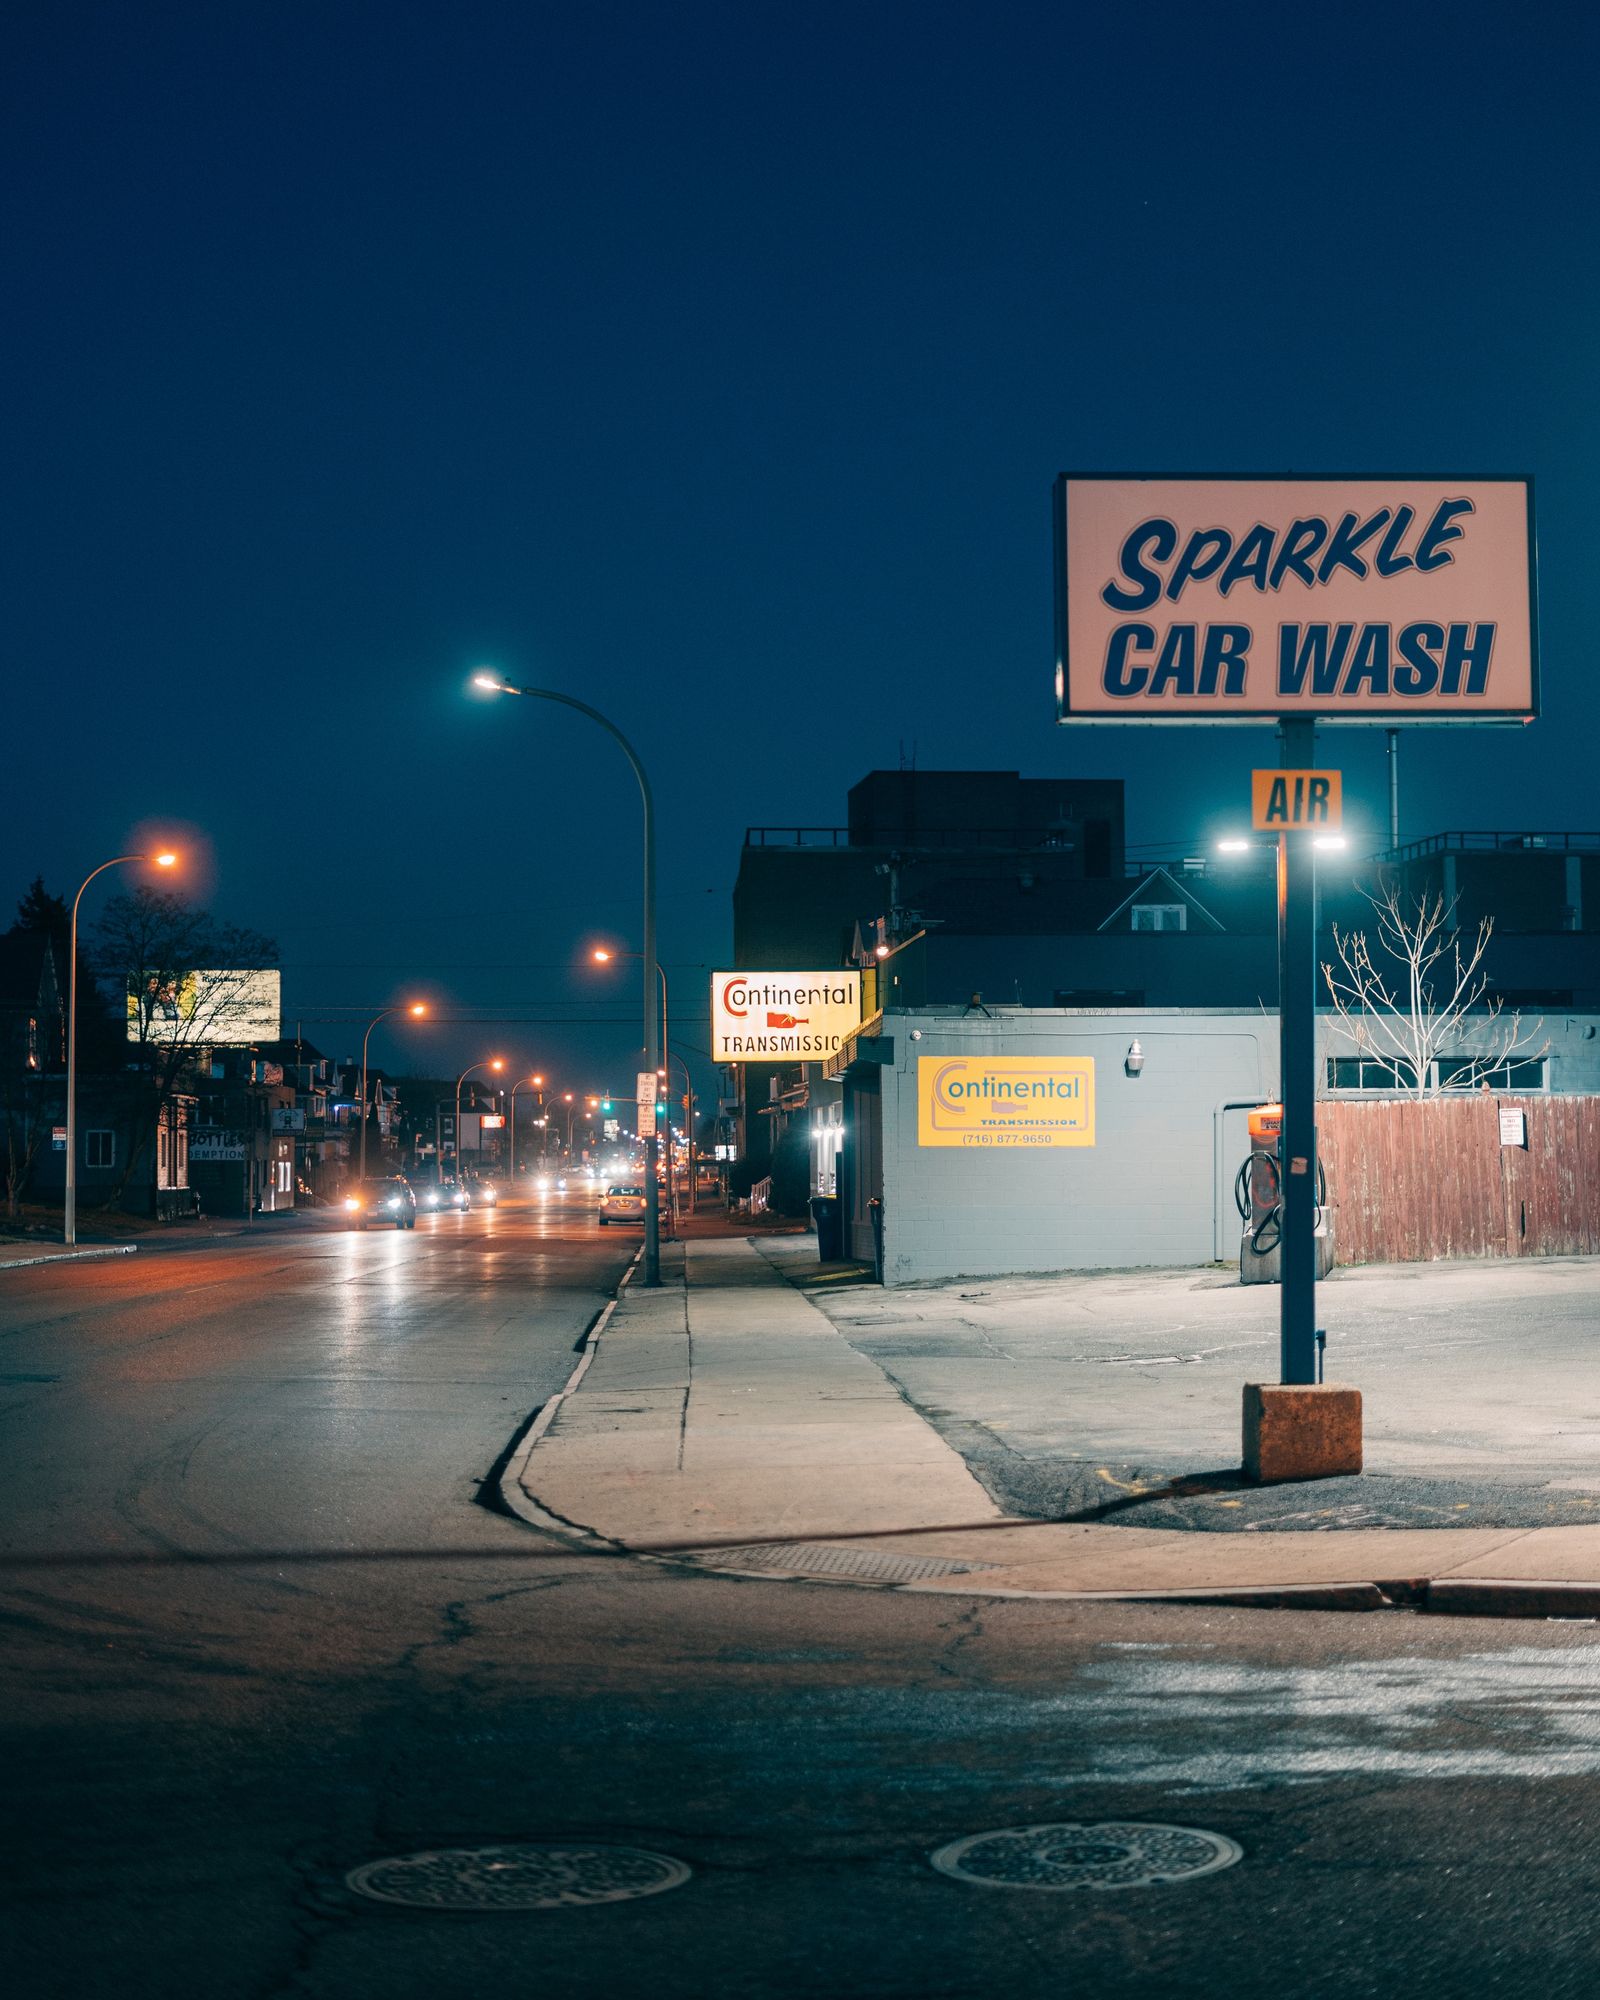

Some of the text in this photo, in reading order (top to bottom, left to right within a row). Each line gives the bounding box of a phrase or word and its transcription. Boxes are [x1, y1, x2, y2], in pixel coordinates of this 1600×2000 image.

[1100, 497, 1476, 613] SPARKLE
[1101, 621, 1498, 698] CAR WASH
[1265, 777, 1330, 823] AIR
[723, 978, 853, 1017] Continental
[934, 1063, 1079, 1113] Continental
[962, 1134, 1052, 1145] (716) 877-9650
